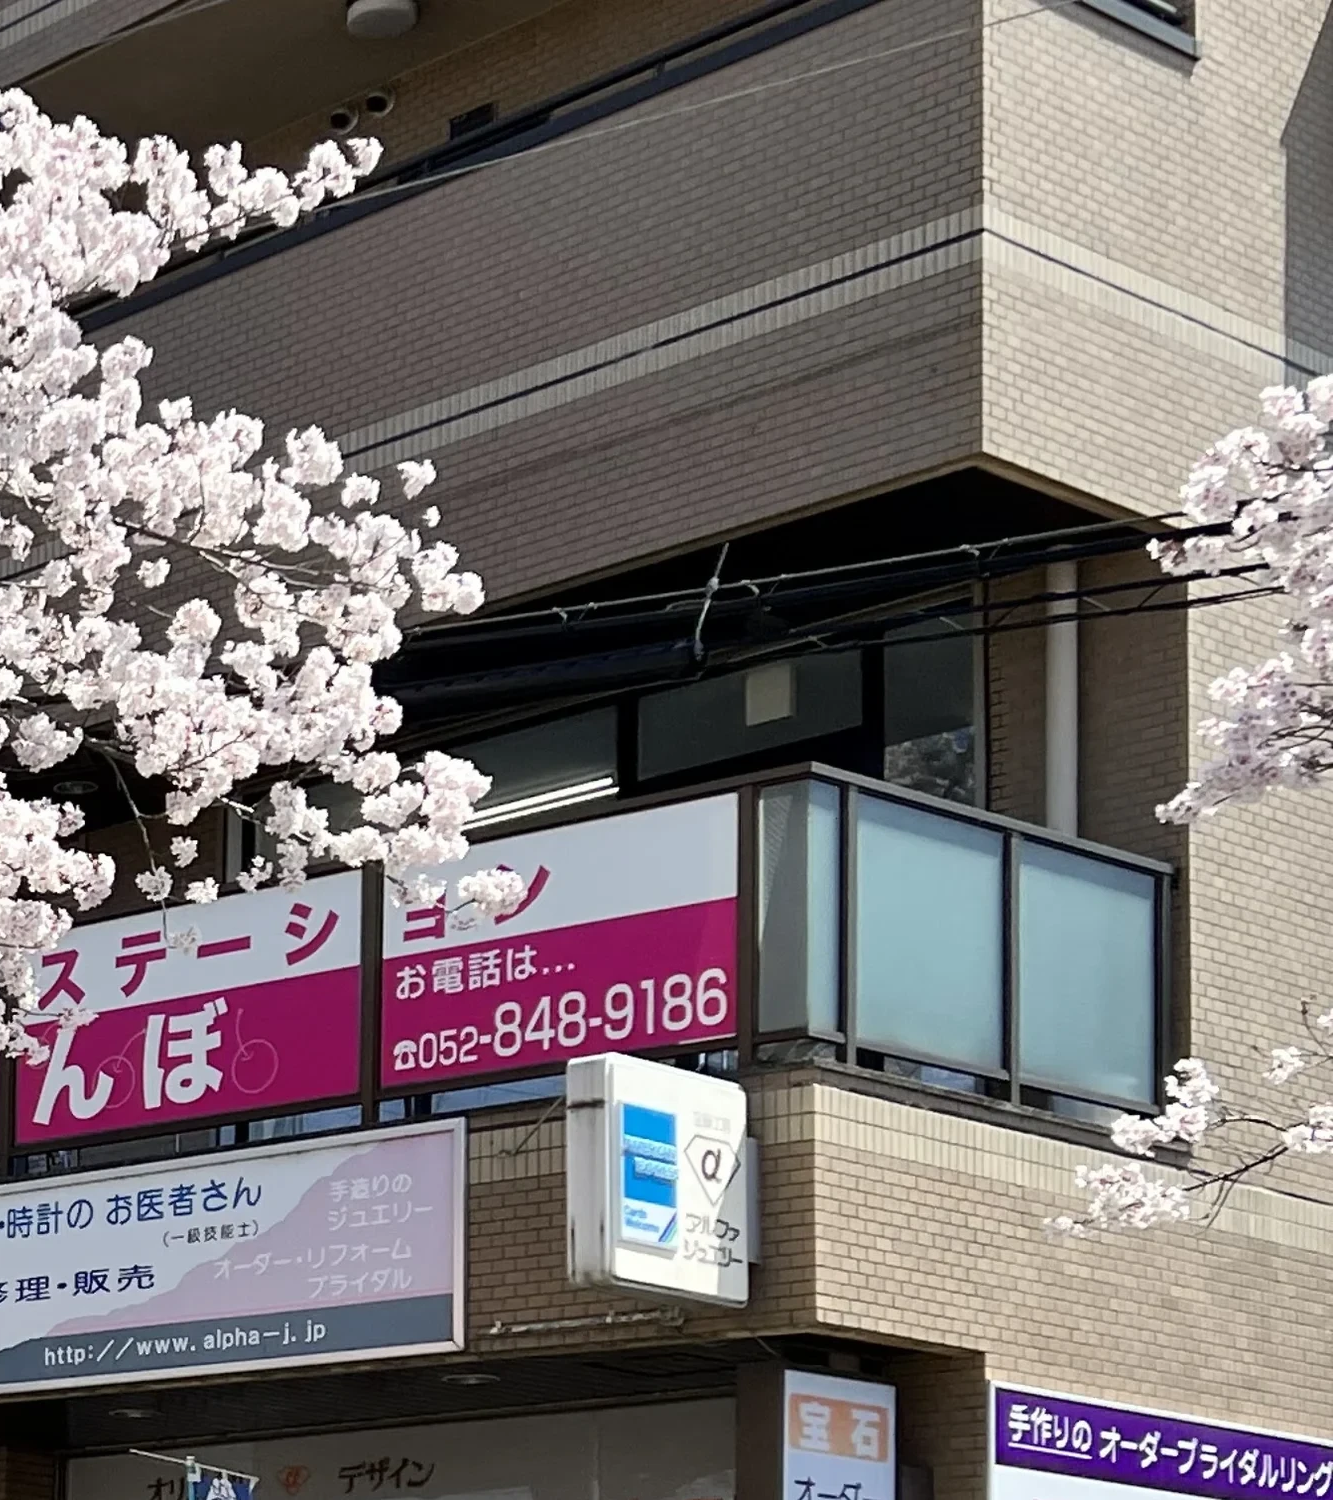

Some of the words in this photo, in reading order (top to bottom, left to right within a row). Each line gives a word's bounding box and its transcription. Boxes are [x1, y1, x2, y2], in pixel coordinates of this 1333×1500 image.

[419, 967, 728, 1069] 052-848-9186
[106, 1177, 262, 1225] お医者さん
[329, 1174, 412, 1202] 手造りの
[327, 1201, 433, 1230] ジュエリー
[214, 1238, 412, 1280] オーダー・リフォーム
[798, 1401, 881, 1460] 宝石
[1008, 1404, 1093, 1453] 手作りの
[338, 1456, 435, 1493] デザイン
